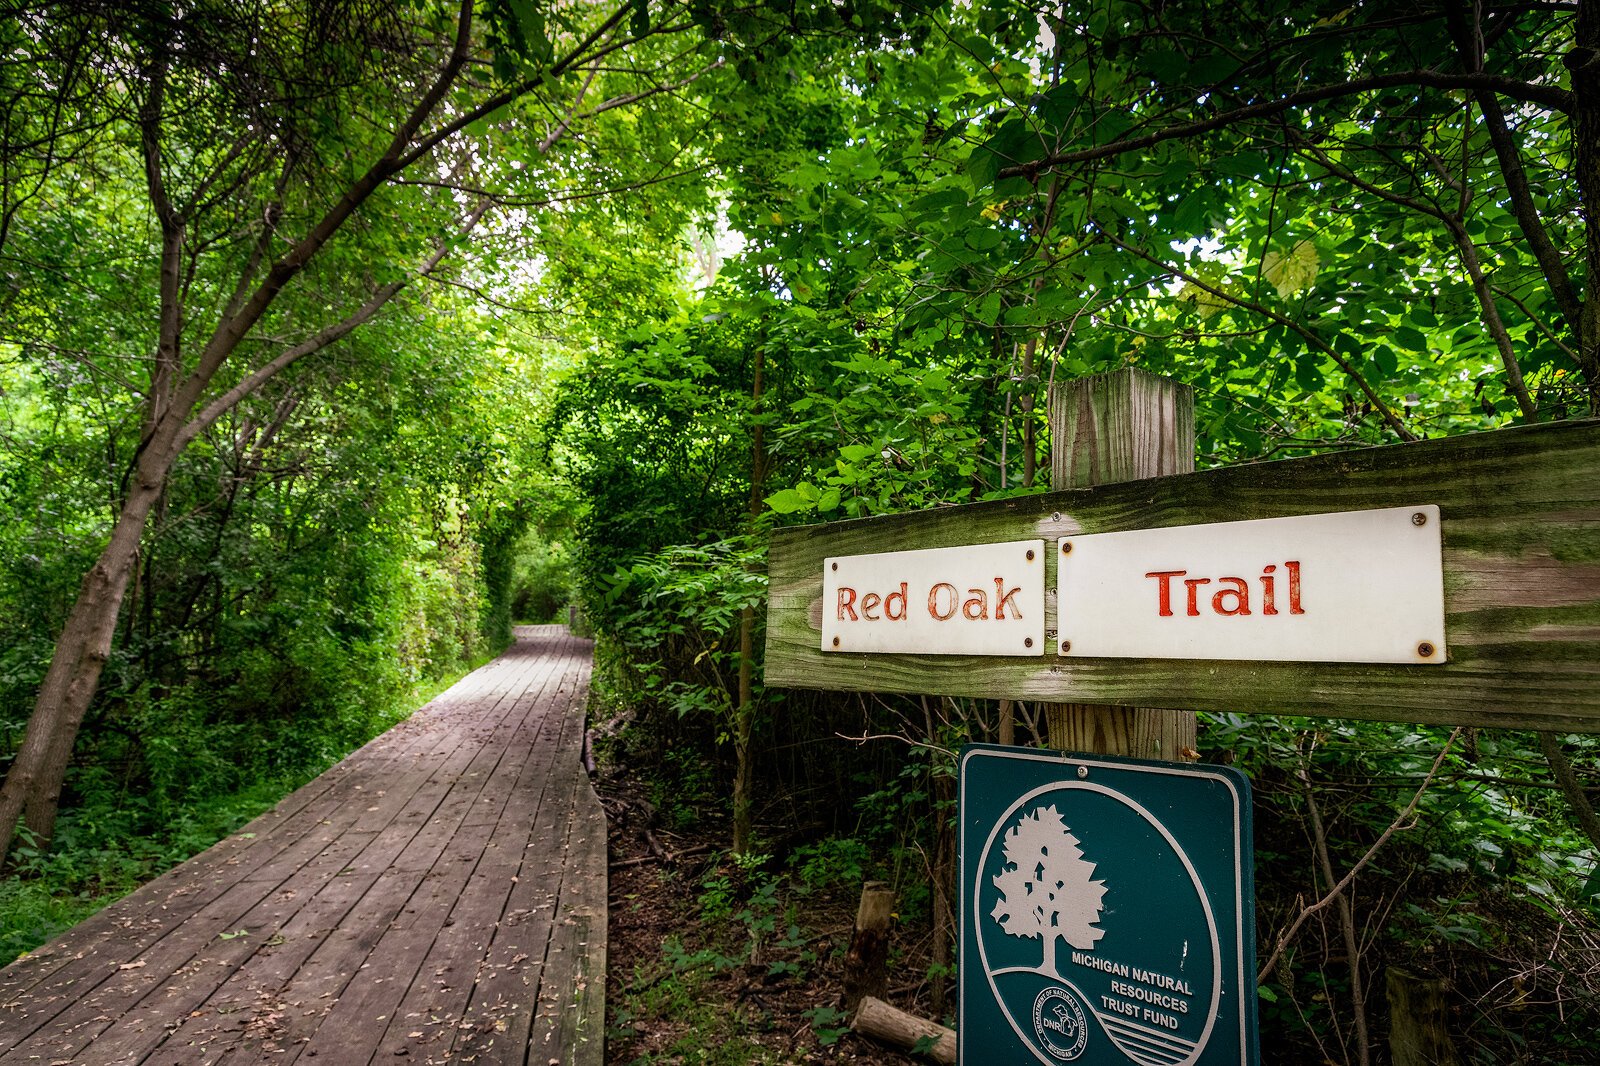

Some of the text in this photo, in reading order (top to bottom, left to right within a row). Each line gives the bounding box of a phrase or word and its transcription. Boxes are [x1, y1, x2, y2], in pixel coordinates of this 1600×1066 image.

[837, 577, 1022, 621] Red Oak
[1145, 561, 1305, 616] Trail
[1072, 951, 1193, 996] MICHIGAN NATURAL
[1052, 989, 1076, 1008] NATURAL
[1101, 995, 1179, 1029] TRUST FUND
[1111, 980, 1188, 1013] RESOURCES
[1043, 1017, 1061, 1032] DNR
[1048, 1043, 1073, 1058] MICHIGAN
